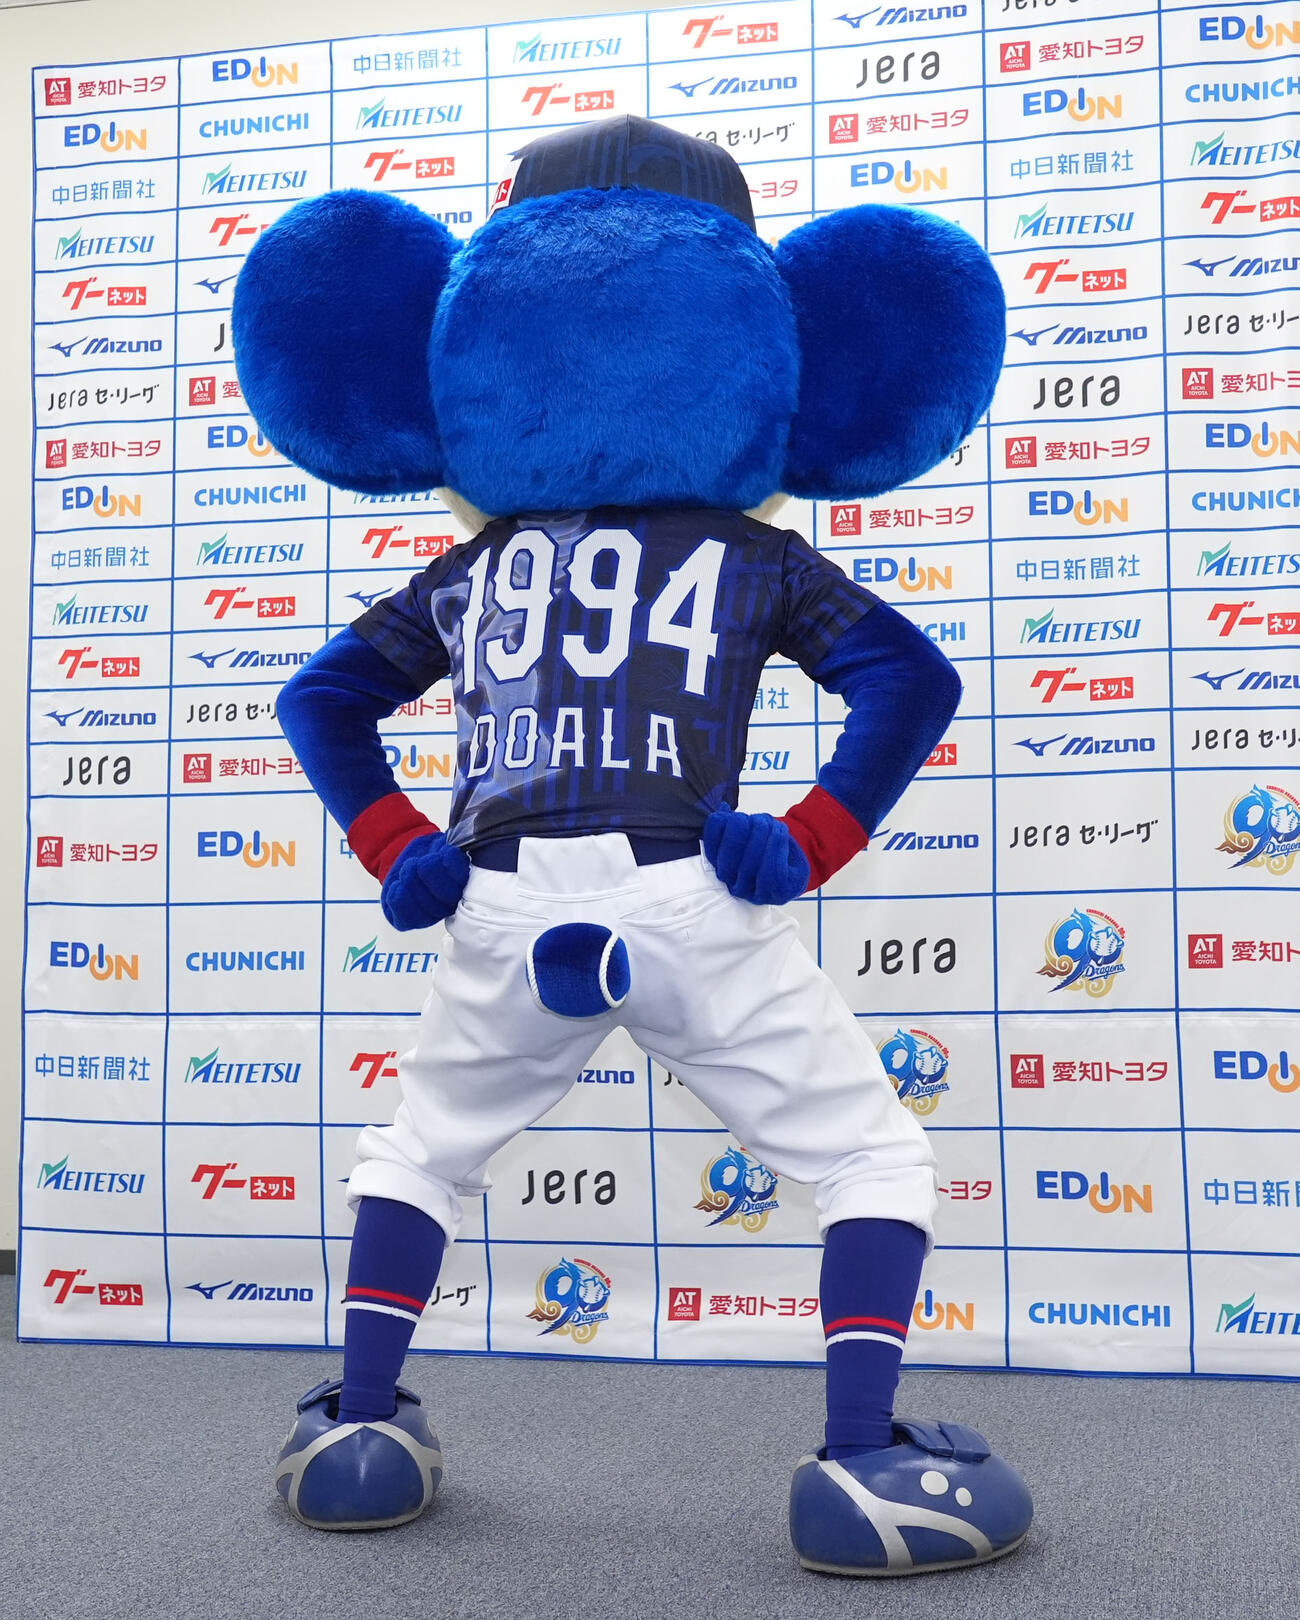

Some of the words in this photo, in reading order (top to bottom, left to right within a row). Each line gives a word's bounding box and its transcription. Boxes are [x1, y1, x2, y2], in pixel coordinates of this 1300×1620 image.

[512, 32, 622, 62] MEITETSU
[1004, 44, 1026, 60] AT
[1038, 35, 1145, 63] 愛知トヨタ
[212, 56, 298, 88] EDION
[353, 48, 461, 74] 中日新聞社
[49, 80, 67, 95] AT
[78, 75, 167, 99] 愛知トヨタ
[356, 97, 462, 129] MEITETSU
[1023, 87, 1122, 122] EDION
[199, 112, 309, 138] CHUNICHI
[726, 122, 795, 146] セ・リーグ
[833, 117, 854, 132] AT
[866, 109, 969, 135] 愛知トヨタ
[64, 121, 147, 152] EDION
[851, 160, 947, 193] EDION
[1011, 149, 1134, 180] 中日新聞社
[202, 161, 307, 195] MEITETSU
[52, 179, 155, 205] 中日新聞社
[1014, 203, 1134, 239] MEITETSU
[55, 226, 155, 260] MEITETSU
[193, 380, 212, 394] AT
[1187, 371, 1208, 386] AT
[95, 384, 160, 405] セ・リーグ
[50, 443, 64, 457] AT
[72, 440, 161, 460] 愛知トヨタ
[1010, 440, 1031, 456] AT
[1045, 437, 1152, 461] 愛知トヨタ
[62, 485, 141, 518] EDION
[194, 484, 306, 507] CHUNICHI
[1029, 490, 1128, 526] EDION
[835, 508, 856, 523] AT
[869, 506, 974, 528] 愛知トヨタ
[51, 546, 149, 570] 中日新聞社
[196, 532, 304, 566] MEITETSU
[853, 557, 952, 592] EDION
[1016, 554, 1140, 582] 中日新聞社
[52, 594, 149, 625] MEITETSU
[461, 528, 727, 696] 1994
[1020, 608, 1141, 644] MEITETSU
[467, 706, 683, 778] DOALA
[187, 757, 207, 771] AT
[1080, 820, 1158, 845] セ・リーグ
[41, 839, 59, 854] AT
[70, 843, 158, 862] 愛知トヨタ
[198, 830, 296, 868] EDION
[1193, 938, 1217, 954] AT
[50, 941, 139, 981] EDION
[186, 951, 305, 972] CHUNICHI
[1080, 963, 1126, 980] Dragons
[35, 1053, 151, 1081] 中日新聞社
[184, 1047, 302, 1083] MEITETSU
[1016, 1058, 1038, 1074] AT
[1052, 1061, 1168, 1082] 愛知トヨタ
[908, 1082, 950, 1099] Dragons
[37, 1155, 146, 1194] MEITETSU
[1036, 1170, 1153, 1213] EDION
[1204, 1178, 1300, 1207] 中日新
[739, 1199, 779, 1216] Dragons
[673, 1292, 696, 1307] AT
[708, 1295, 820, 1317] 愛知トヨタ
[568, 1310, 609, 1327] Dragons
[1028, 1302, 1170, 1327] CHUNICHI
